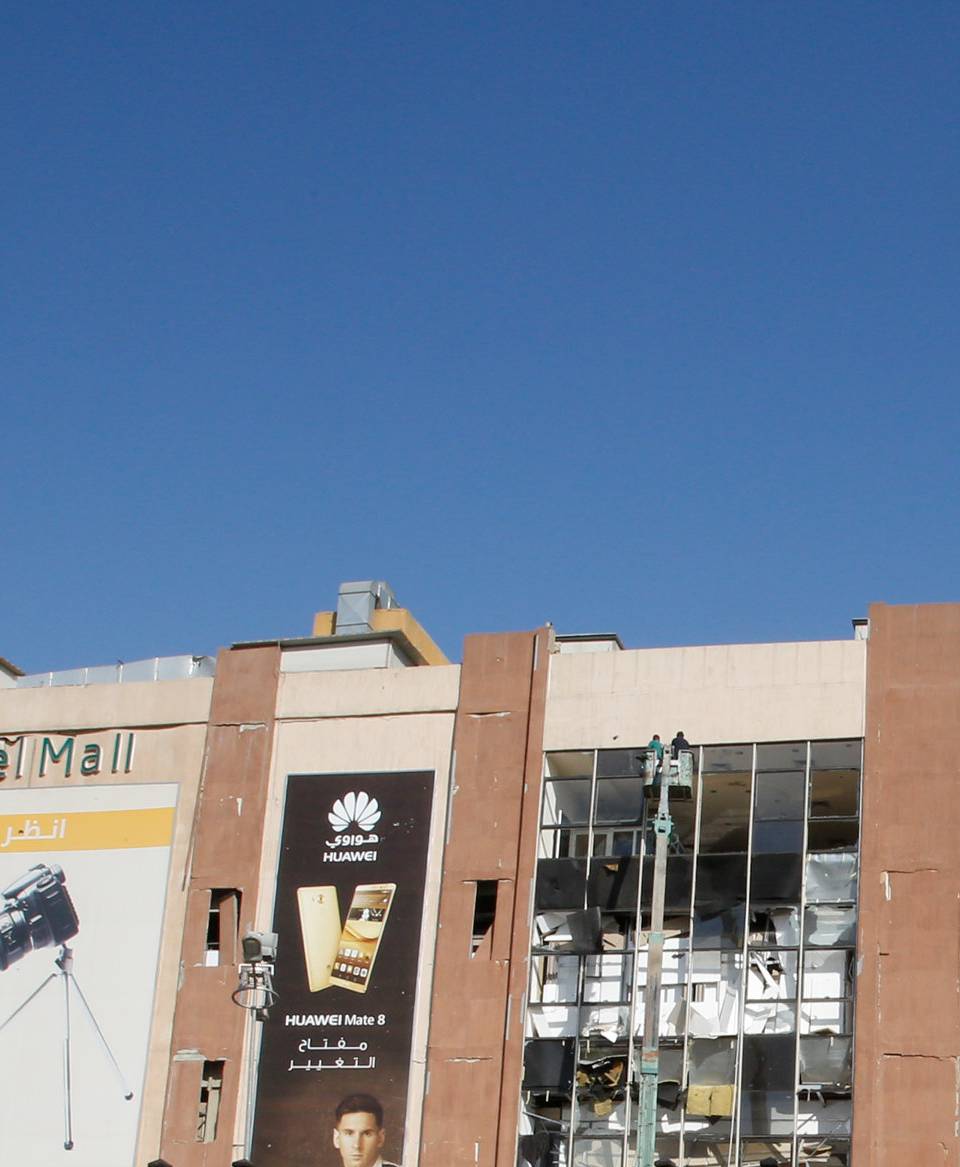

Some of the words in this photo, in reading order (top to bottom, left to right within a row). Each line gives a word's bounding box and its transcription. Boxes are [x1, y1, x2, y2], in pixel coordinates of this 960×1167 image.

[39, 732, 135, 778] Mall
[325, 834, 379, 849] هواوي
[323, 850, 378, 863] HUAWEI
[285, 1014, 343, 1026] HUAWEI
[344, 1014, 375, 1026] Mate
[377, 1014, 386, 1026] 8
[298, 1037, 369, 1053] مفتاح
[287, 1056, 376, 1072] التغيير
